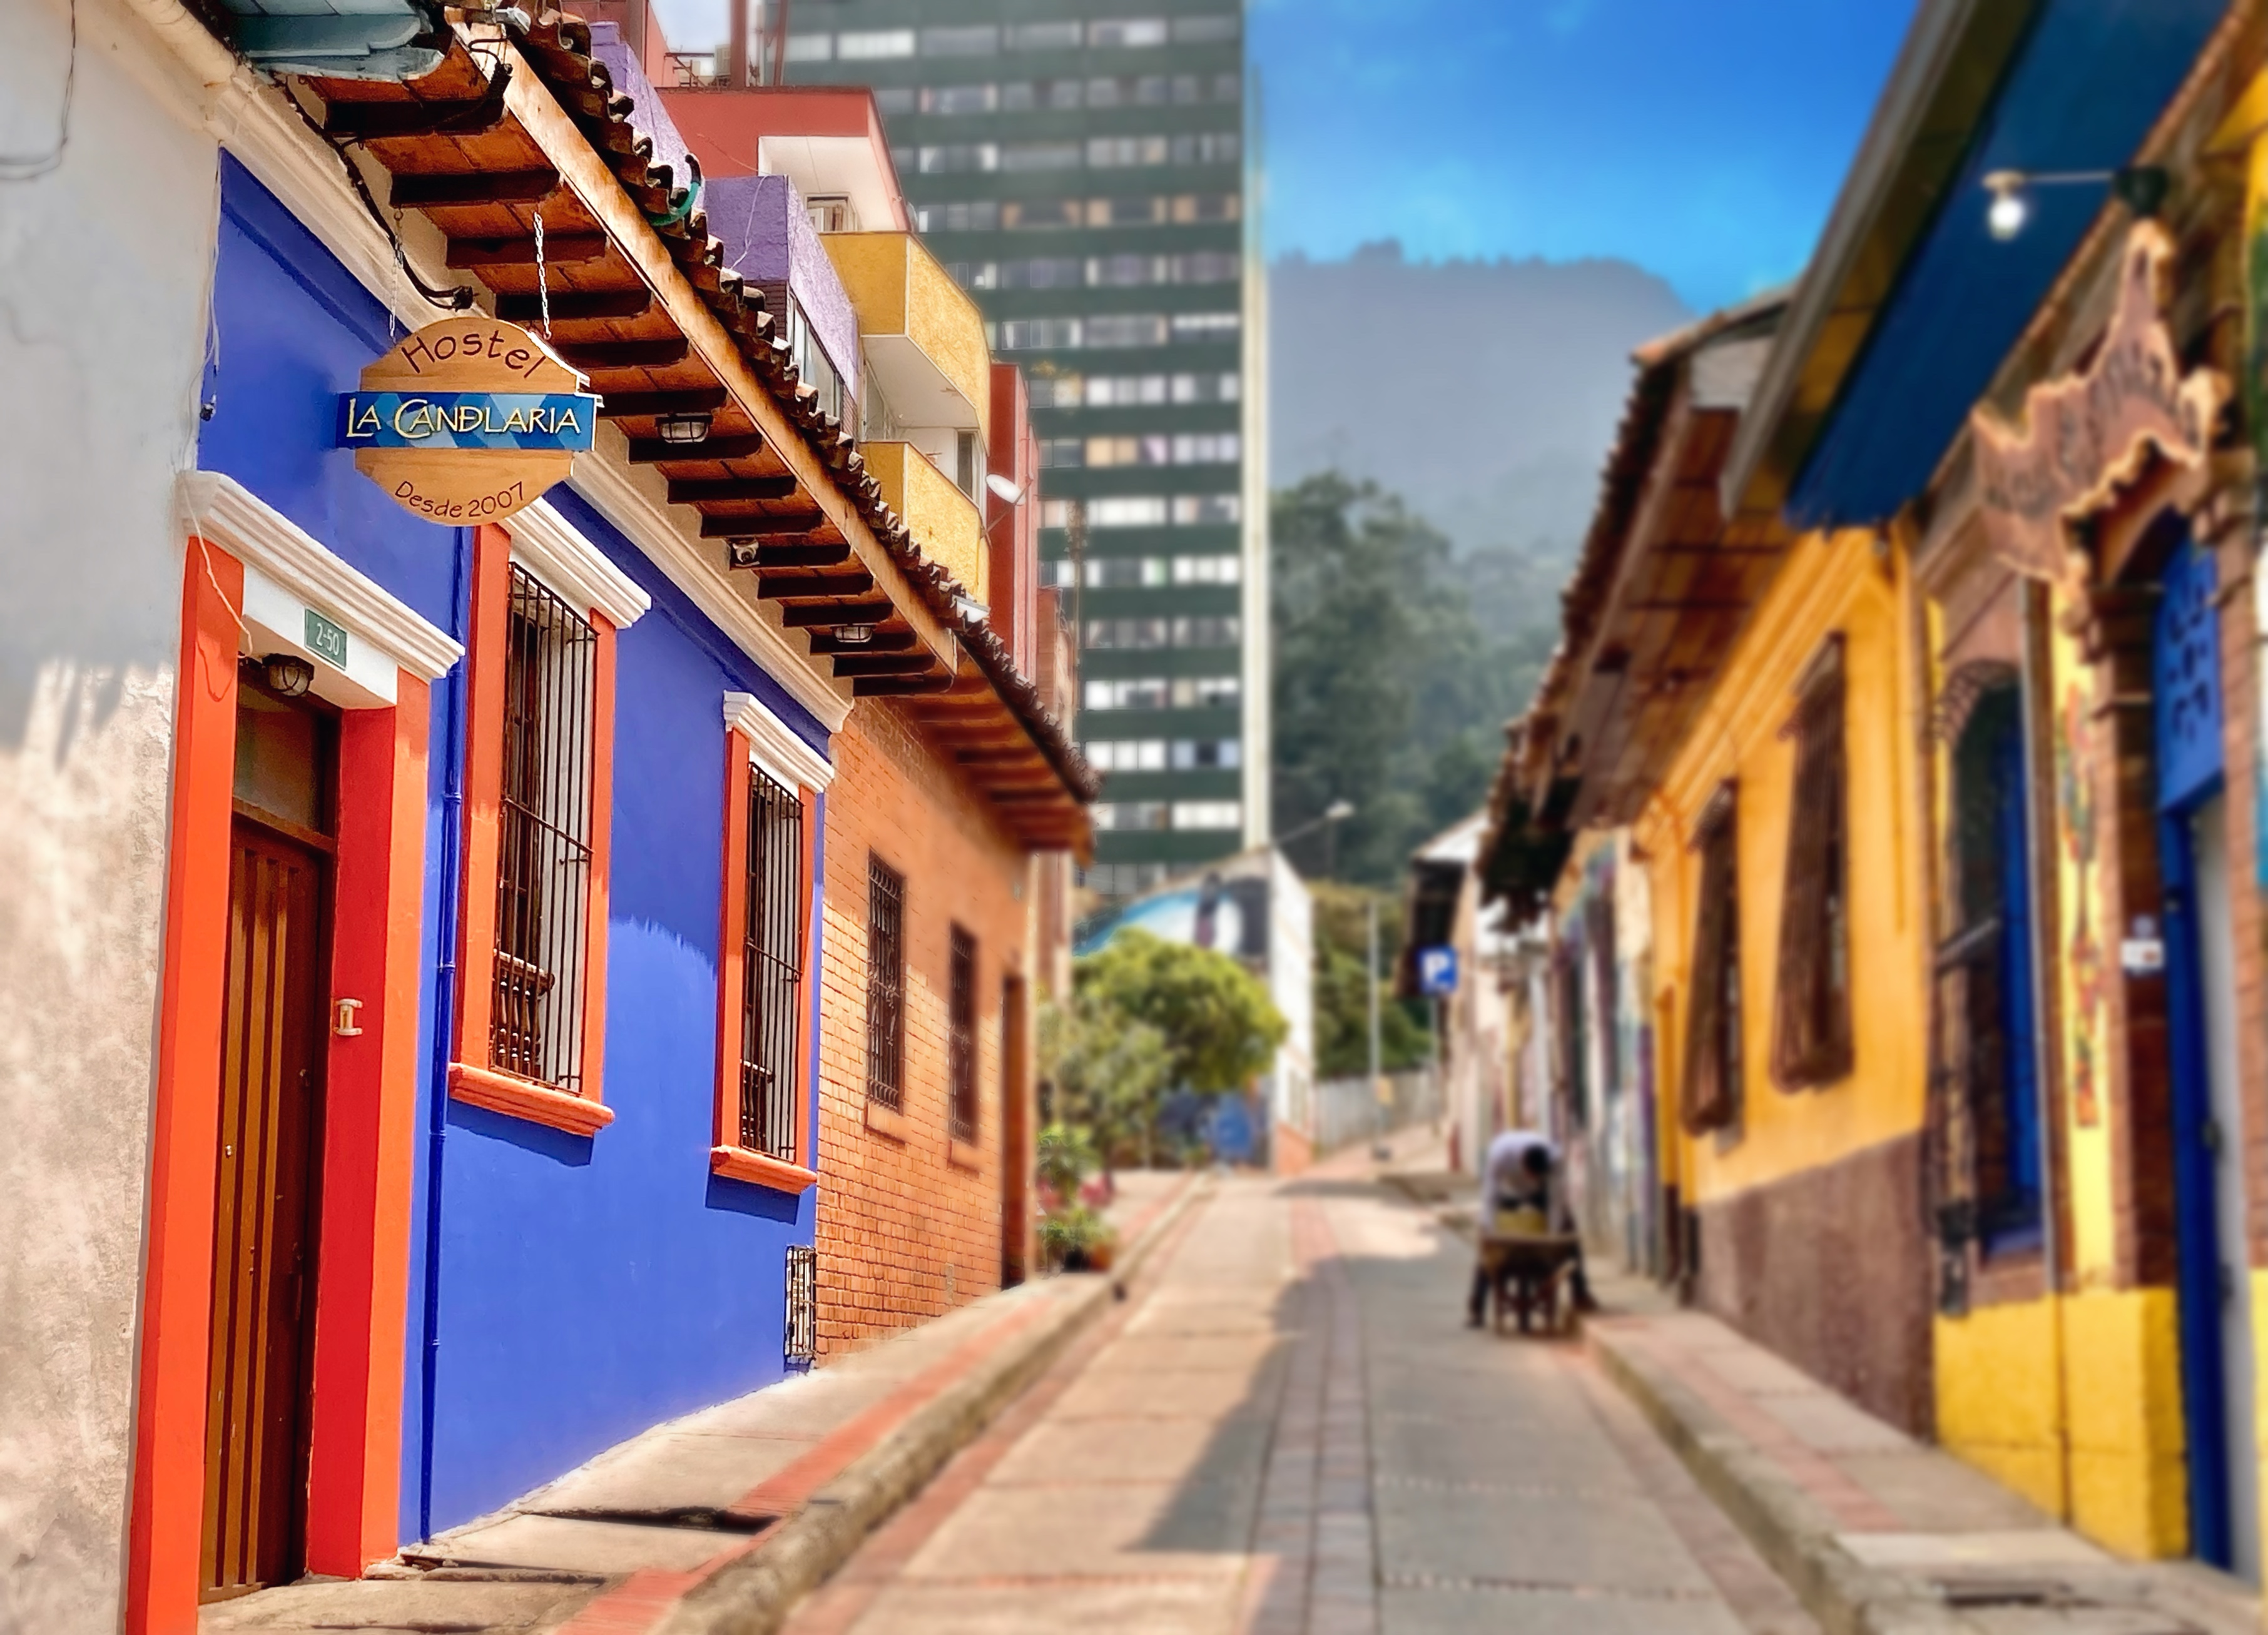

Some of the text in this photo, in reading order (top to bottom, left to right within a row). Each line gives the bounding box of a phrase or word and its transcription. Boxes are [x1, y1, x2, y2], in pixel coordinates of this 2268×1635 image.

[401, 330, 546, 378] Hostel
[346, 398, 382, 437] LA
[394, 480, 524, 518] Desde 2007
[316, 622, 340, 656] 2-50
[1424, 951, 1450, 985] P
